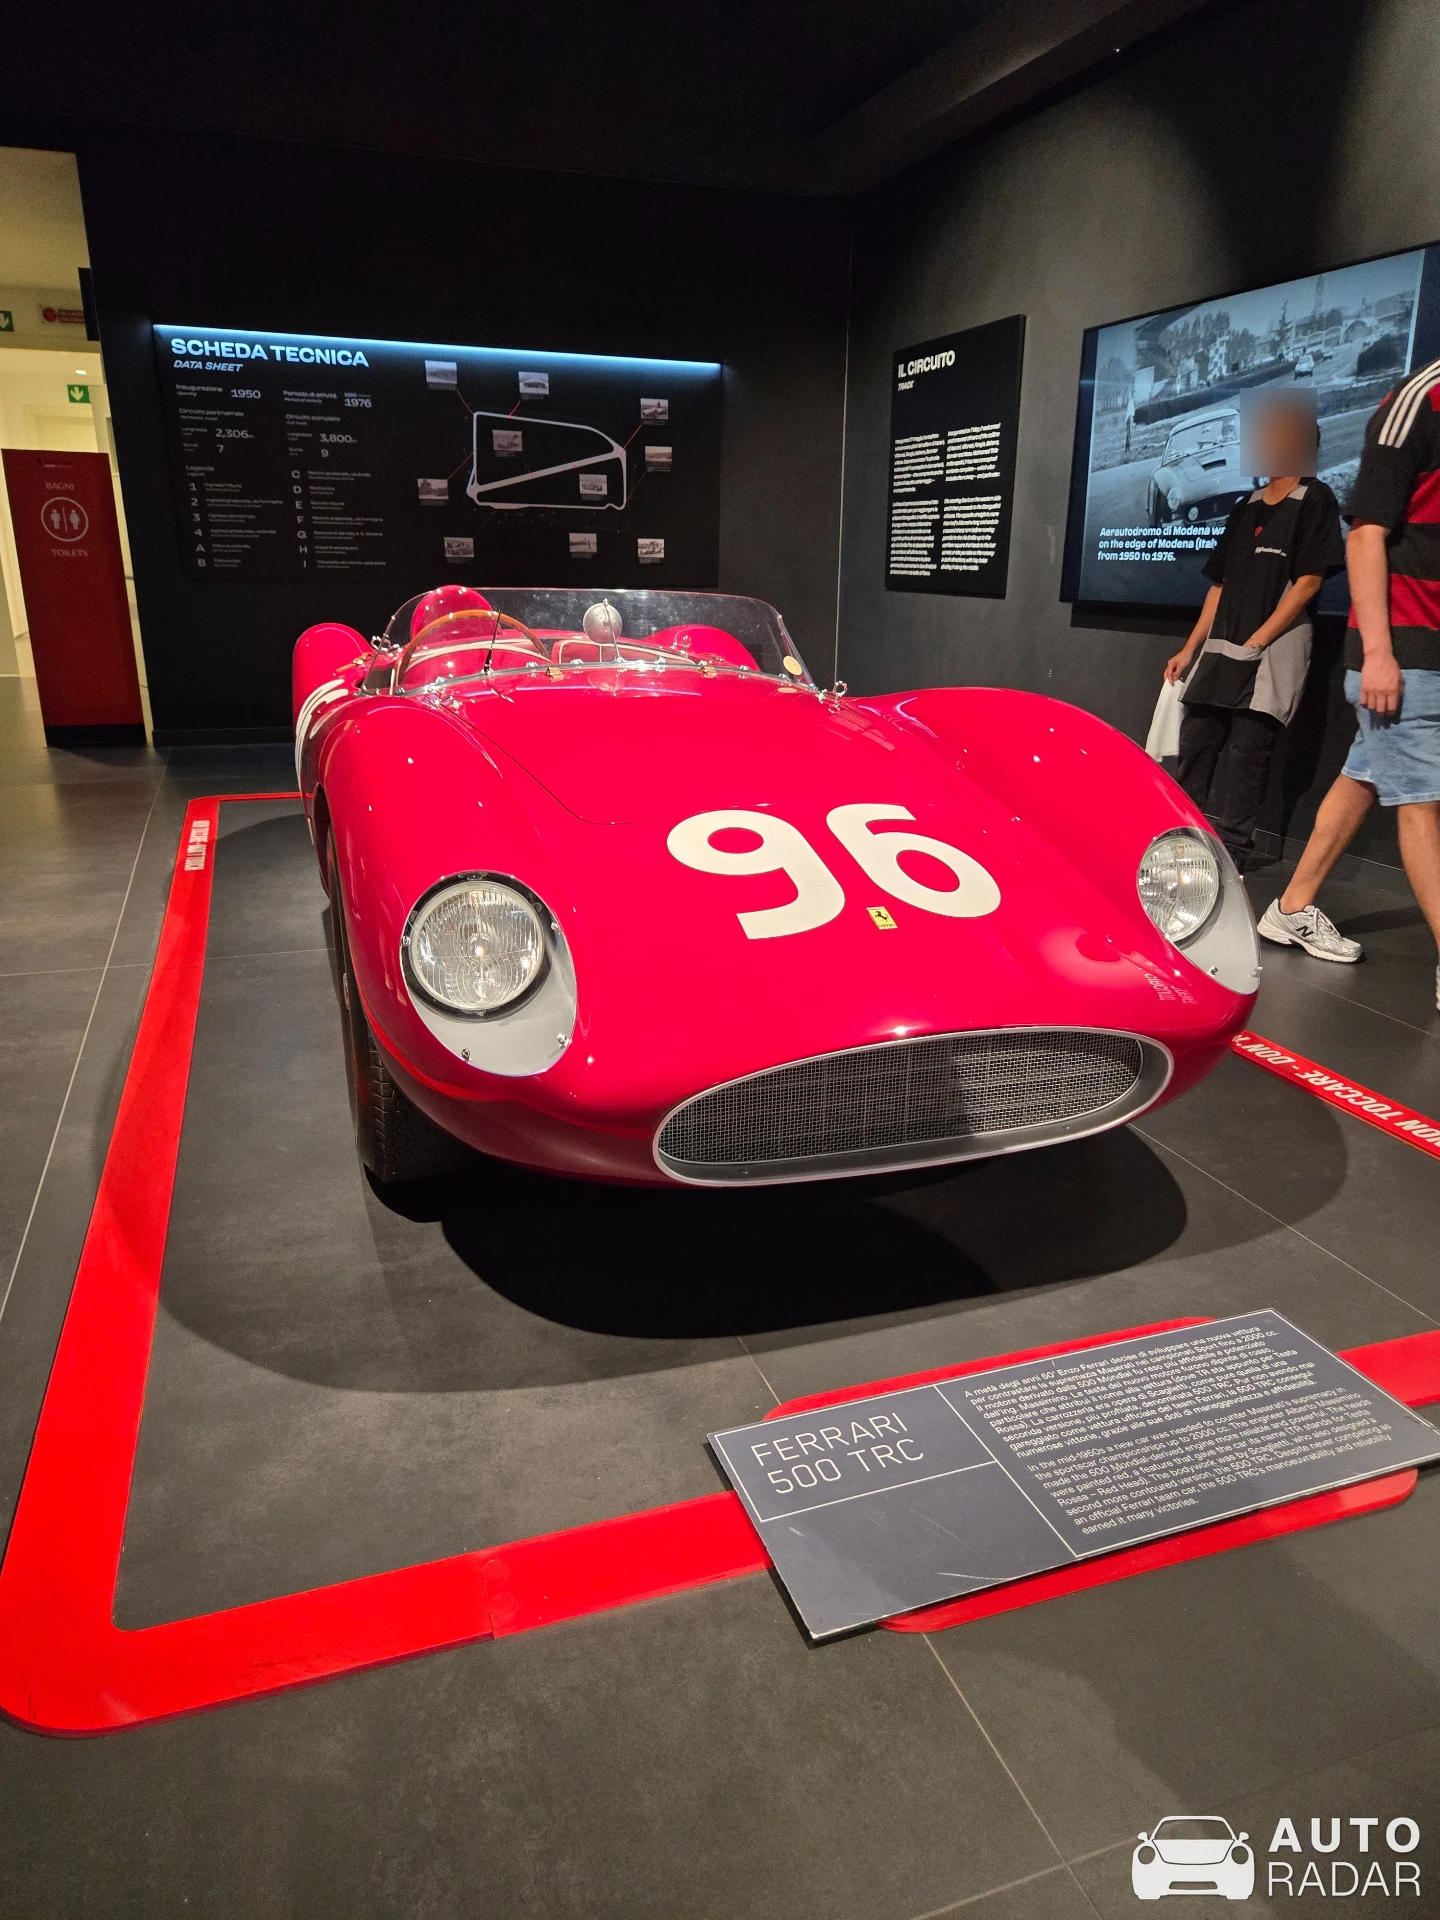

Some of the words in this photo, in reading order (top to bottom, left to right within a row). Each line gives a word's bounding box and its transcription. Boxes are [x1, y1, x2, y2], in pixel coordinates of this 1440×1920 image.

[171, 338, 268, 361] SCHEDA
[270, 345, 369, 368] TECNICA
[173, 360, 203, 370] DATA
[205, 362, 244, 372] SHEET
[898, 364, 906, 378] IL
[907, 350, 956, 376] CIRCUITO
[231, 389, 261, 399] 1950
[344, 398, 372, 408] 1976
[216, 444, 224, 453] 7
[321, 448, 329, 457] 9
[291, 470, 301, 479] C
[46, 482, 74, 491] BAGNI
[189, 482, 198, 491] 1
[293, 485, 302, 494] D
[295, 500, 304, 510] E
[194, 528, 203, 537] 4
[1100, 526, 1162, 537] Aerautodromo
[1163, 526, 1172, 536] di
[1173, 526, 1210, 536] Modena
[195, 543, 206, 552] A
[299, 545, 308, 554] H
[1099, 539, 1109, 548] on
[1111, 538, 1123, 548] the
[1125, 538, 1146, 550] edge
[1148, 538, 1157, 548] of
[1158, 538, 1194, 549] Modena
[50, 548, 88, 557] TOILETS
[1097, 551, 1118, 561] from
[1118, 551, 1140, 561] 1950
[1141, 551, 1150, 561] to
[1151, 551, 1176, 561] 1976.
[666, 803, 1001, 940] 96
[1296, 925, 1314, 938] N
[1294, 1069, 1404, 1120] TOCCARE
[1038, 1460, 1057, 1469] the
[1057, 1448, 1106, 1464] mid-1950s
[1114, 1441, 1134, 1450] new
[1134, 1436, 1150, 1445] car
[1150, 1431, 1170, 1440] was
[1170, 1422, 1204, 1435] needed
[1214, 1411, 1247, 1424] counter
[1291, 1390, 1337, 1404] supremacy
[751, 1412, 908, 1466] FERRARI
[1034, 1471, 1053, 1480] the
[1053, 1460, 1097, 1476] sportscar
[1099, 1442, 1166, 1464] championships
[1189, 1428, 1216, 1440] 2000
[1228, 1421, 1249, 1429] The
[1248, 1411, 1285, 1425] engineer
[1285, 1404, 1317, 1416] Alberto
[1315, 1393, 1361, 1407] Massimino
[1043, 1477, 1071, 1489] made
[1071, 1473, 1089, 1481] the
[1088, 1465, 1110, 1477] 500
[1110, 1447, 1184, 1471] Mondial-derived
[1184, 1439, 1215, 1452] engine
[1215, 1433, 1240, 1444] more
[1239, 1425, 1271, 1437] reliable
[1270, 1419, 1289, 1429] and
[1325, 1406, 1346, 1414] The
[1343, 1399, 1372, 1410] heads
[1050, 1487, 1075, 1497] were
[1076, 1476, 1112, 1493] painted
[1139, 1461, 1174, 1473] feature
[1173, 1454, 1195, 1465] that
[1194, 1449, 1217, 1461] gave
[1215, 1445, 1233, 1453] the
[1232, 1440, 1248, 1449] car
[1247, 1437, 1262, 1445] its
[1260, 1431, 1287, 1441] name
[1303, 1419, 1333, 1430] stands
[1331, 1415, 1346, 1423] for
[1343, 1409, 1370, 1419] Testa
[767, 1458, 841, 1494] 500
[847, 1439, 924, 1472] TRC
[1057, 1494, 1089, 1507] Rossa
[1096, 1485, 1119, 1496] Red
[1148, 1472, 1170, 1481] The
[1169, 1459, 1218, 1476] bodywork
[1216, 1454, 1236, 1464] was
[1291, 1434, 1312, 1443] who
[1312, 1429, 1331, 1438] also
[1330, 1418, 1370, 1433] designed
[1066, 1500, 1102, 1516] second
[1102, 1494, 1129, 1506] more
[1129, 1480, 1178, 1498] contoured
[1213, 1466, 1232, 1475] the
[1230, 1459, 1252, 1470] 500
[1273, 1445, 1310, 1458] Despite
[1309, 1439, 1334, 1449] never
[1334, 1427, 1382, 1444] competing
[1088, 1506, 1122, 1521] official
[1121, 1497, 1155, 1511] Ferrari
[1154, 1491, 1181, 1502] team
[1198, 1481, 1217, 1490] the
[1215, 1474, 1237, 1485] 500
[1265, 1449, 1336, 1471] manoeuvrability
[1335, 1443, 1354, 1453] and
[1352, 1434, 1392, 1448] reliability
[1082, 1518, 1117, 1534] earned
[1126, 1509, 1155, 1522] many
